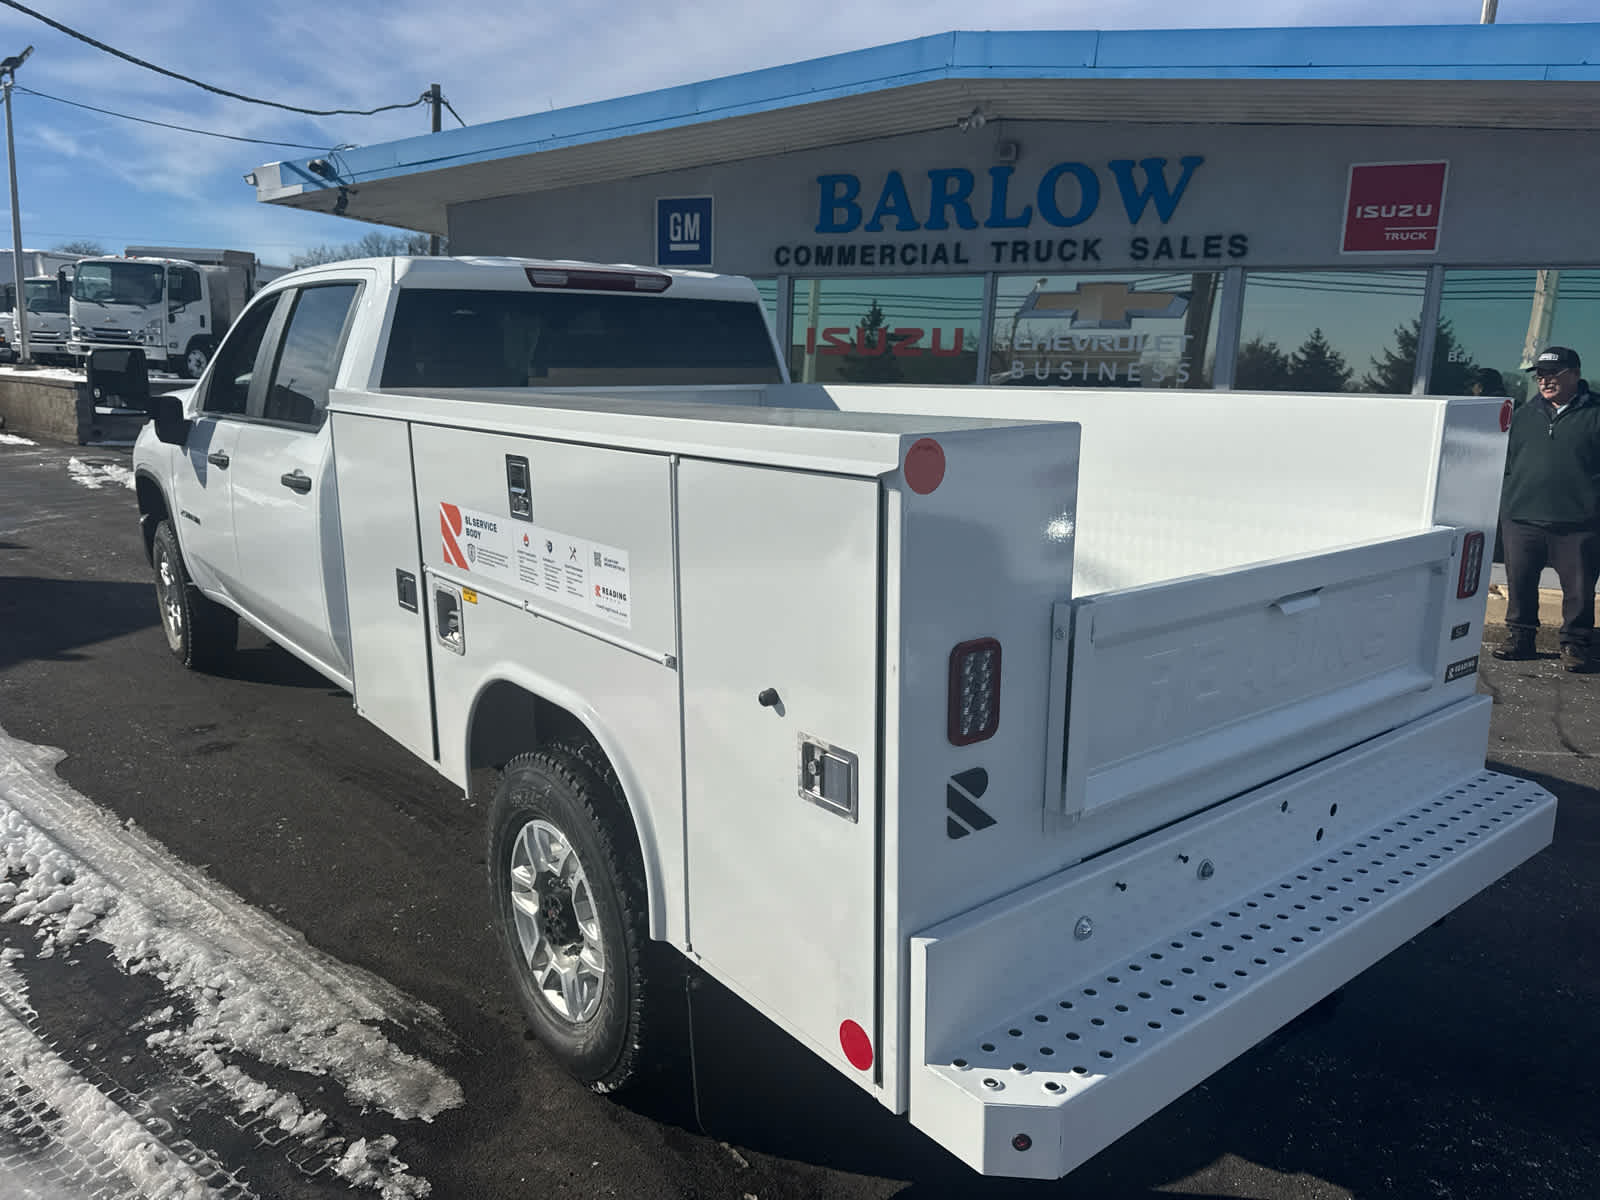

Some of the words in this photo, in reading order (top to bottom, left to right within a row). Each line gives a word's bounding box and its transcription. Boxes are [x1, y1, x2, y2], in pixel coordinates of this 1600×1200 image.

[813, 155, 1205, 233] BARLOW
[1355, 203, 1433, 219] ISUZU
[669, 211, 700, 242] GM
[1384, 231, 1428, 242] TRUCK
[773, 242, 969, 267] COMMERCIAL
[991, 238, 1103, 263] TRUCK
[1129, 233, 1249, 261] SALES
[806, 327, 964, 357] ISUZU
[1013, 333, 1195, 353] CHEVROLET
[1010, 360, 1192, 383] BUSINESS
[465, 527, 481, 540] BODY
[472, 518, 498, 533] SERVICE
[602, 586, 627, 601] READING
